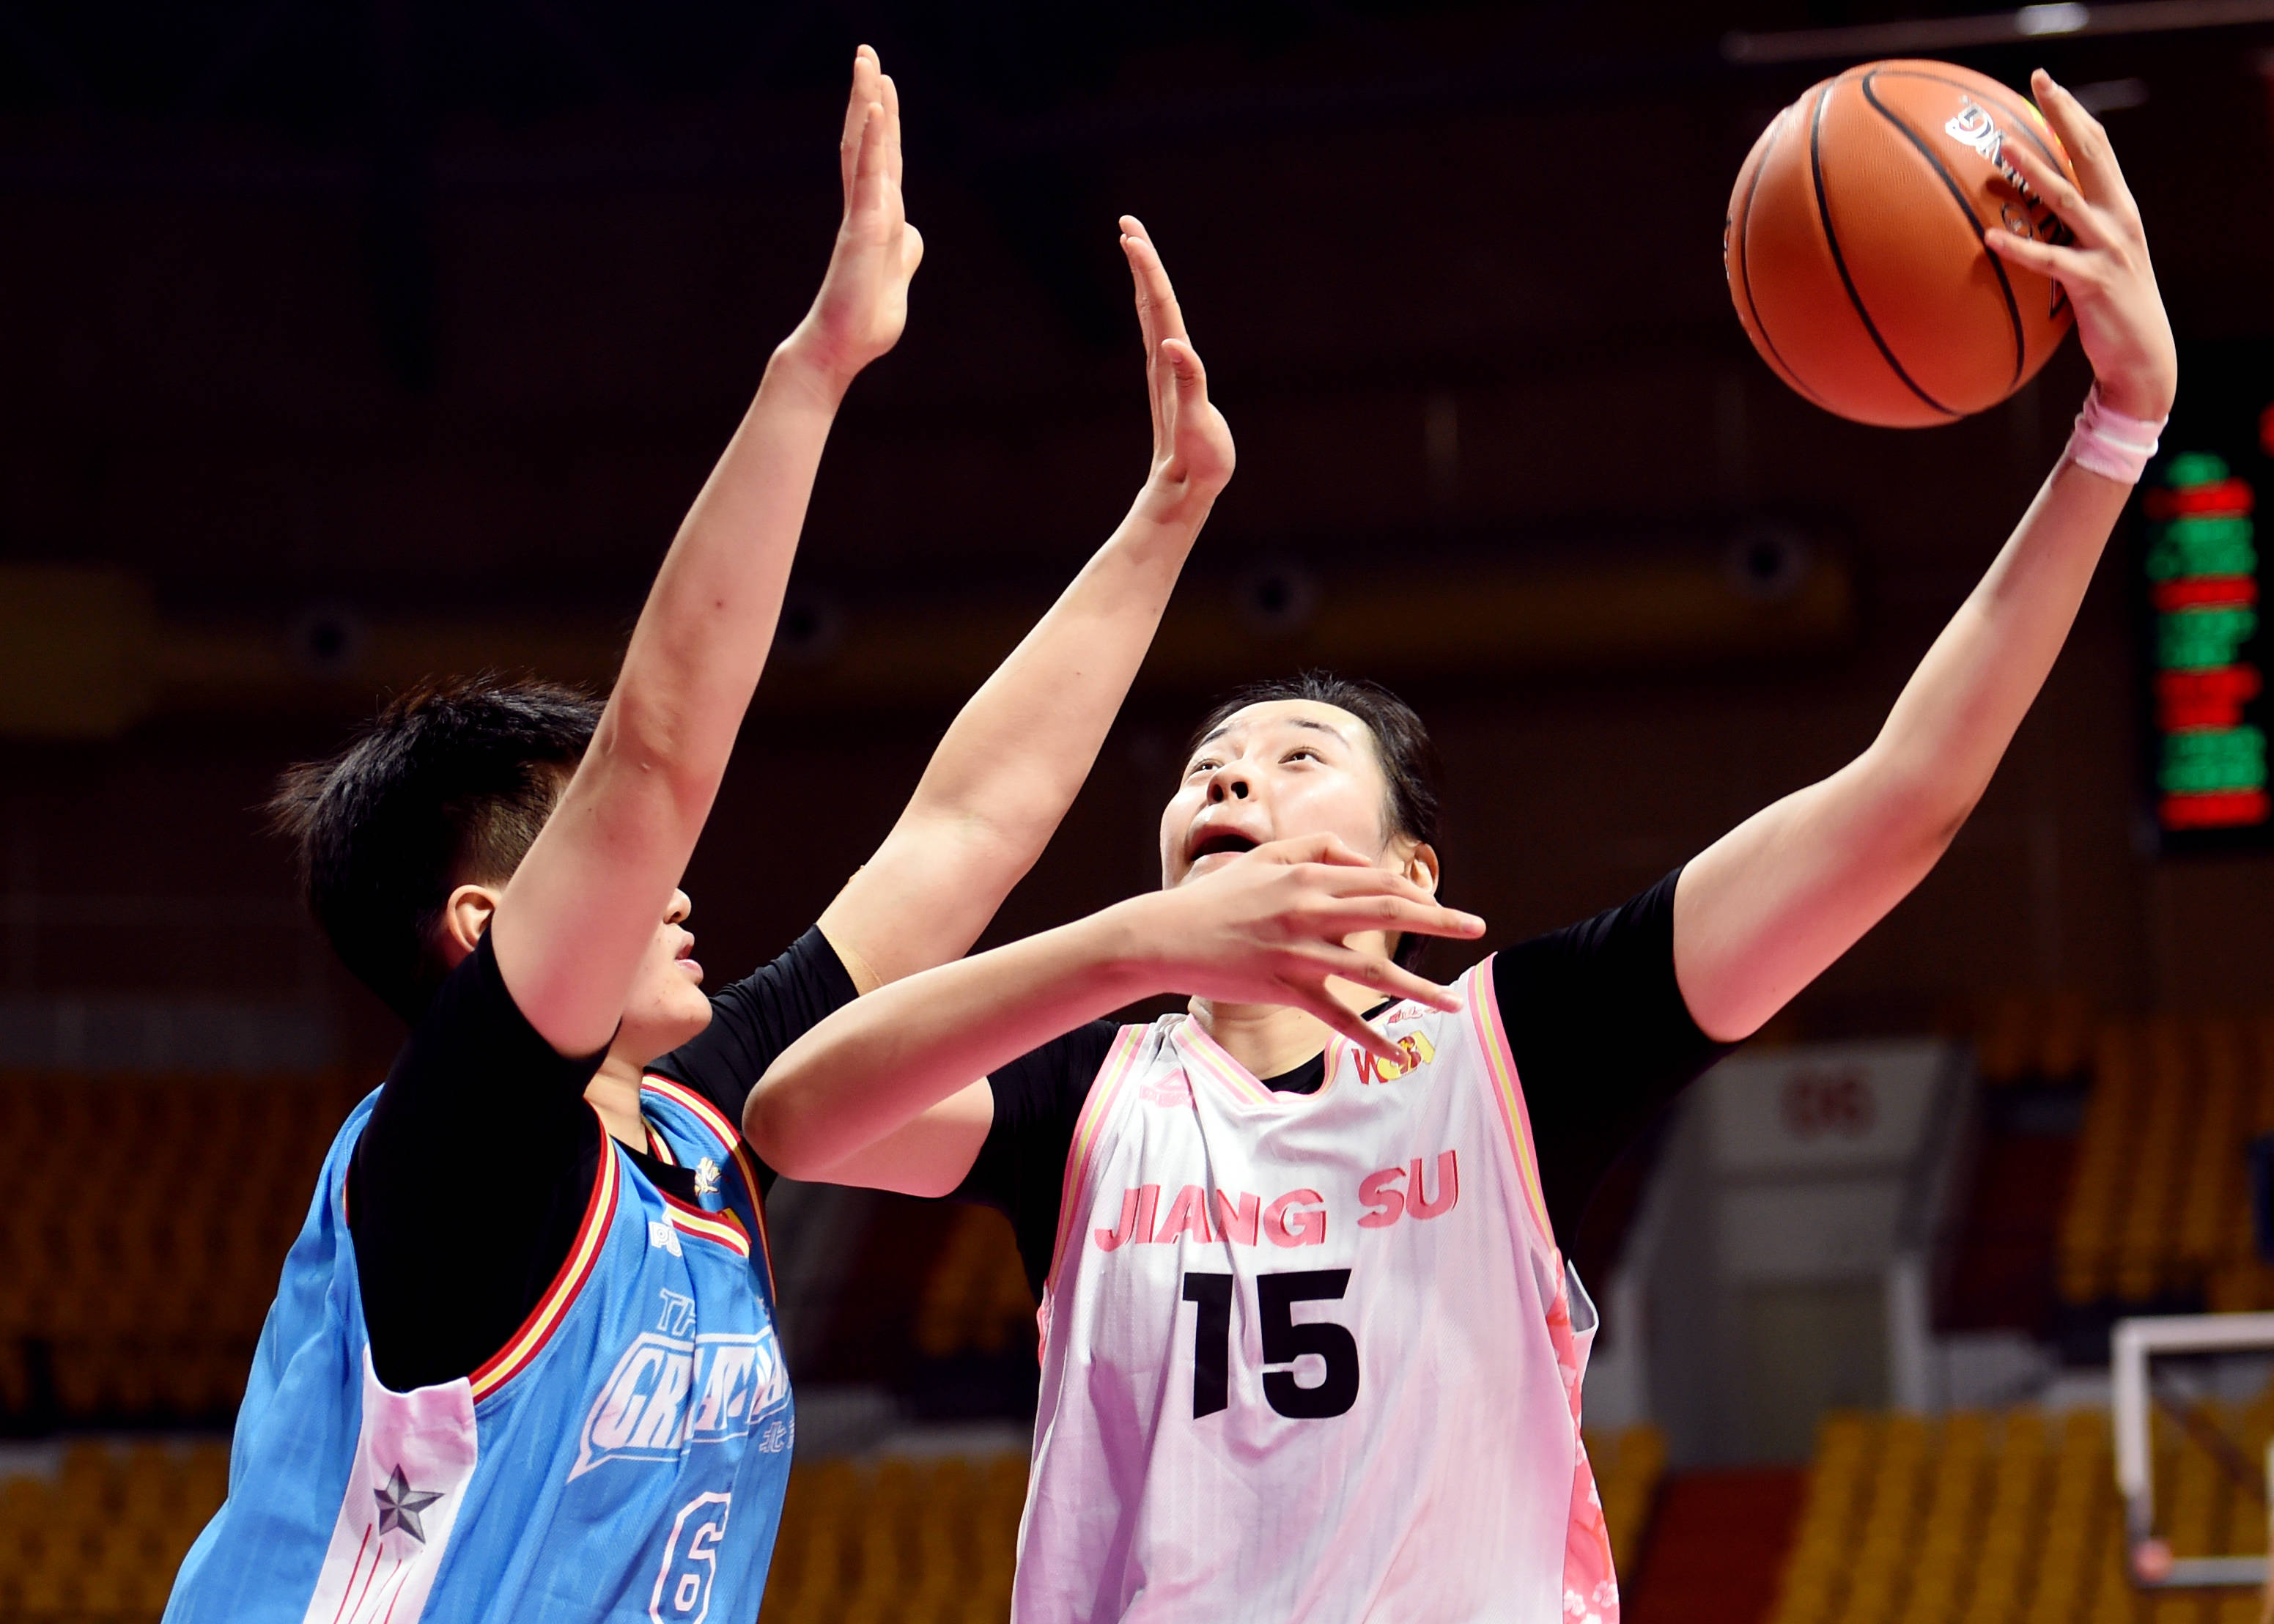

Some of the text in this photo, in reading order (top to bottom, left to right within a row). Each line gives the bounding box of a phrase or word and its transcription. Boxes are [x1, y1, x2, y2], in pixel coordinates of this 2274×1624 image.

[1094, 1150, 1459, 1252] JIANG SU
[1182, 1269, 1359, 1420] 15
[649, 1491, 731, 1623] 6
